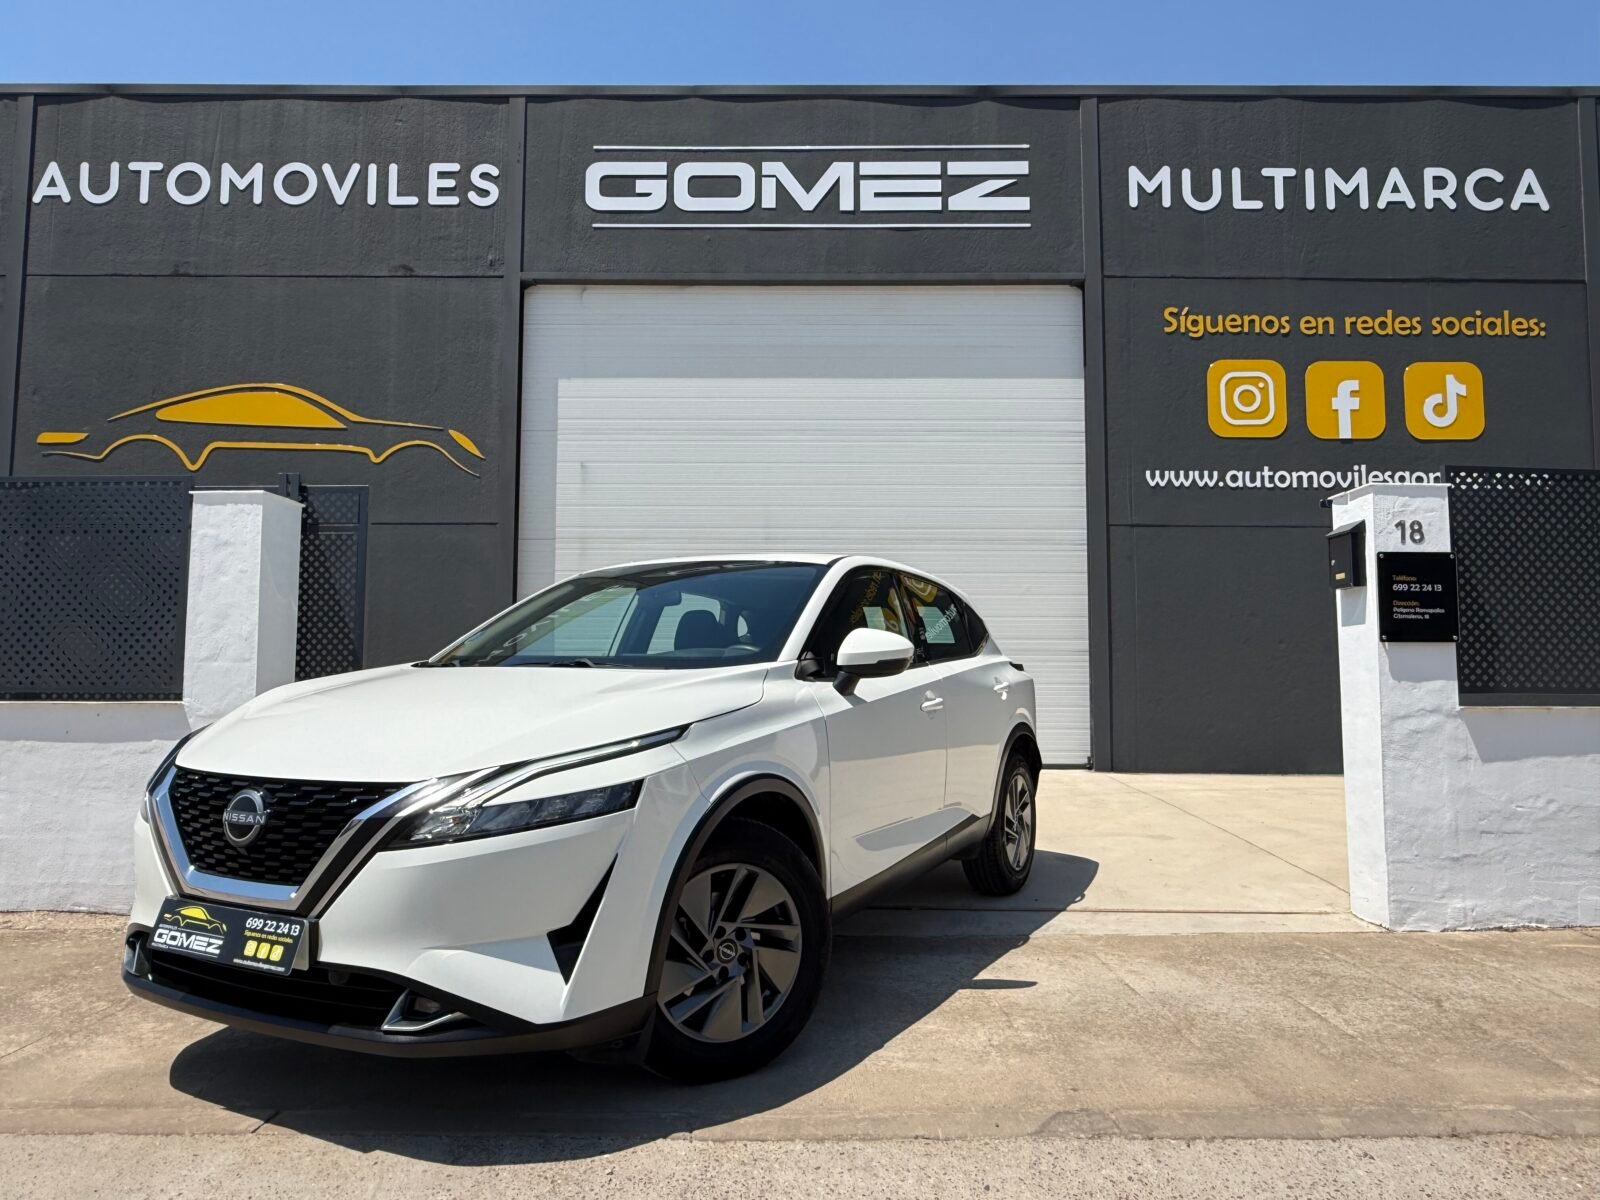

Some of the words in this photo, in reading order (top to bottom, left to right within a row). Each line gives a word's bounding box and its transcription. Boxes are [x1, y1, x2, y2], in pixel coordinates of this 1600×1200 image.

[32, 161, 500, 207] AUTOMOVILES
[584, 160, 1031, 213] GOMEZ
[1128, 165, 1550, 212] MULTIMARCA
[1163, 306, 1291, 338] Síguenos
[1299, 314, 1335, 335] en
[1344, 309, 1421, 335] redes
[1431, 310, 1547, 337] sociales:
[1394, 519, 1425, 546] 18
[1392, 584, 1408, 592] 699
[223, 810, 265, 825] NISSAN
[245, 917, 264, 930] 699
[264, 920, 277, 933] 22
[277, 922, 290, 935] 24
[290, 924, 300, 936] 13
[153, 928, 224, 955] GOMEZ
